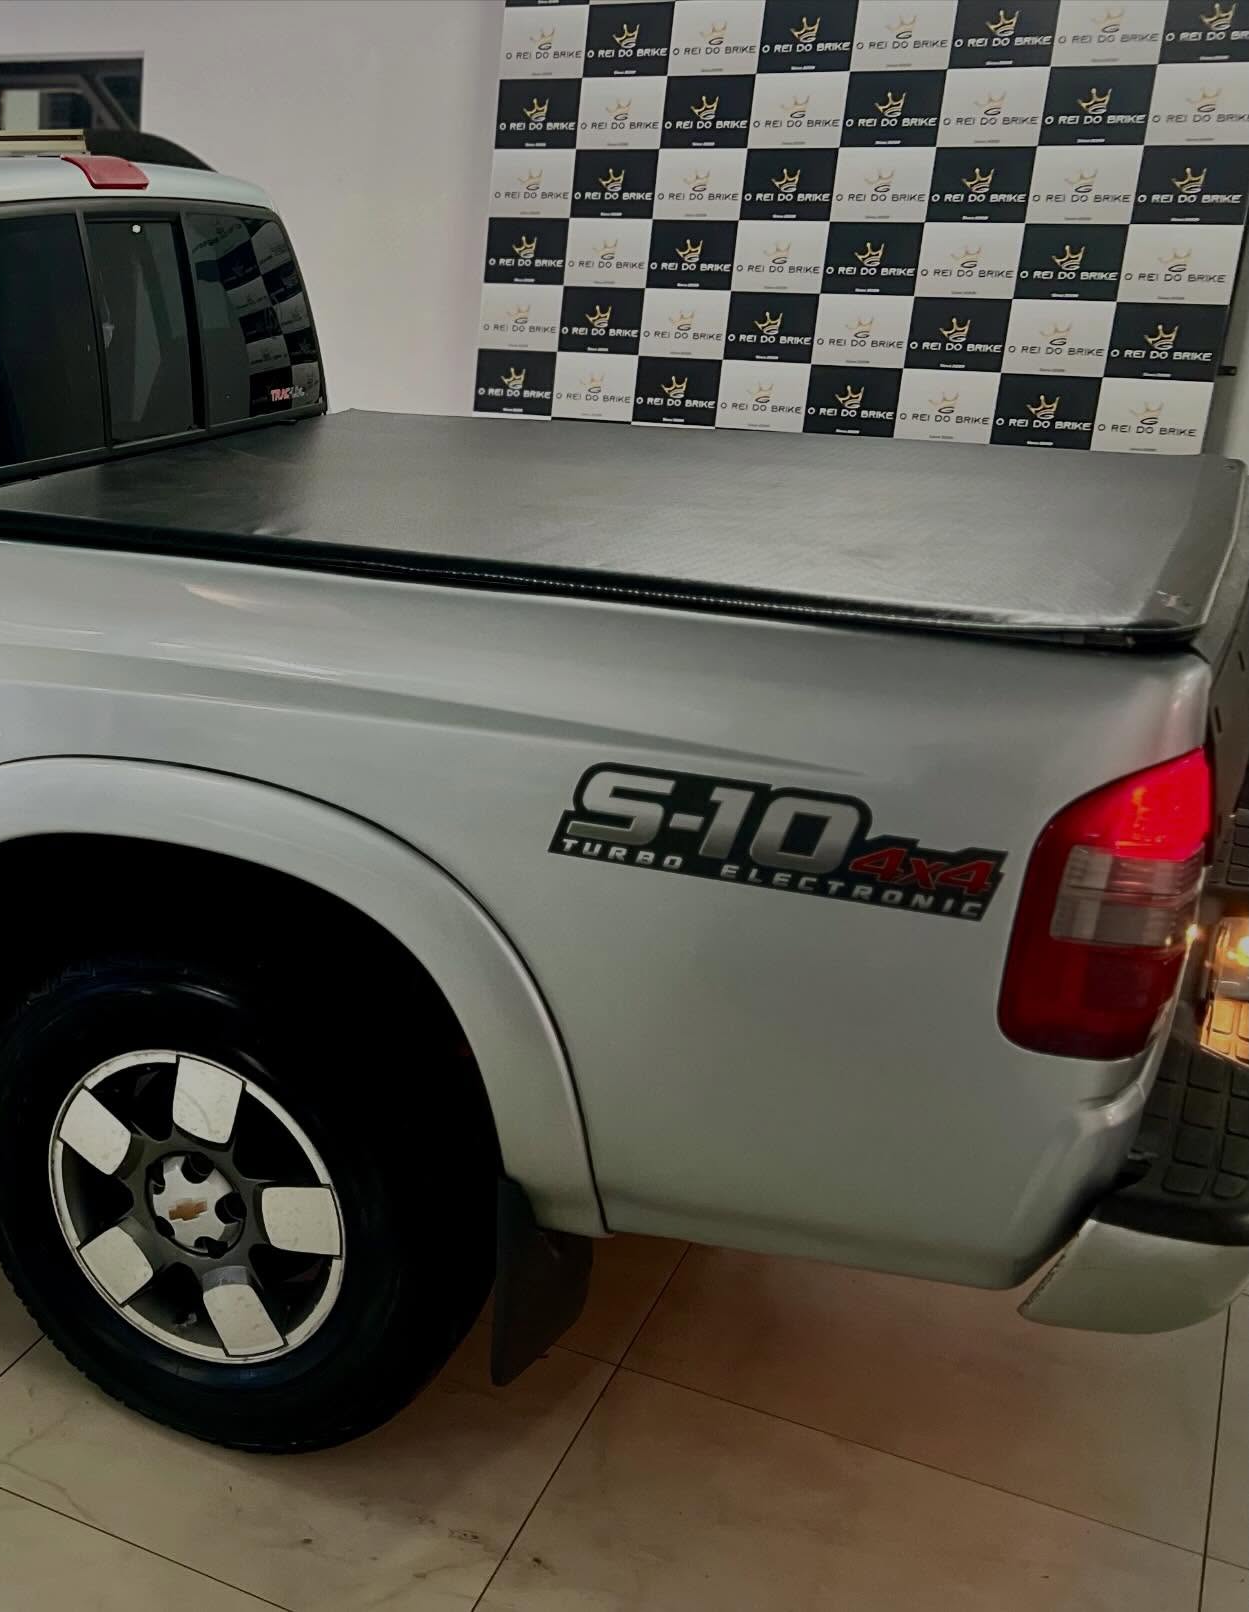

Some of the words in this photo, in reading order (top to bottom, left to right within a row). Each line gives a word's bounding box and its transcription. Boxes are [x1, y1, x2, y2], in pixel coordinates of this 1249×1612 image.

[1179, 31, 1203, 41] REI
[1206, 31, 1226, 41] DO
[912, 39, 948, 49] BRIKE
[967, 38, 989, 47] REI
[991, 37, 1011, 47] DO
[1013, 36, 1052, 46] BRIKE
[597, 49, 615, 58] REI
[618, 48, 634, 58] DO
[636, 47, 668, 57] BRIKE
[724, 45, 757, 55] BRIKE
[773, 44, 793, 53] REI
[796, 43, 813, 53] DO
[816, 42, 851, 52] BRIKE
[857, 118, 878, 127] REI
[880, 118, 898, 127] DO
[901, 117, 938, 127] BRIKE
[1058, 116, 1080, 125] REI
[1083, 115, 1103, 125] DO
[1106, 114, 1146, 124] BRIKE
[509, 122, 526, 131] REI
[528, 122, 543, 131] DO
[546, 121, 577, 131] BRIKE
[629, 121, 660, 130] BRIKE
[675, 121, 694, 130] REI
[696, 120, 713, 130] DO
[715, 120, 749, 129] BRIKE
[584, 191, 602, 200] REI
[604, 192, 619, 201] DO
[622, 192, 653, 201] BRIKE
[707, 193, 739, 201] BRIKE
[755, 193, 774, 202] REI
[777, 193, 794, 202] DO
[796, 193, 831, 202] BRIKE
[891, 193, 926, 202] BRIKE
[943, 194, 965, 203] REI
[967, 194, 986, 203] DO
[989, 194, 1027, 203] BRIKE
[1151, 194, 1174, 203] REI
[1177, 194, 1198, 204] DO
[1201, 194, 1242, 204] BRIKE
[498, 258, 515, 267] REI
[517, 258, 532, 267] DO
[534, 259, 565, 268] BRIKE
[660, 262, 679, 271] REI
[681, 262, 697, 271] DO
[699, 263, 732, 272] BRIKE
[788, 265, 820, 275] BRIKE
[837, 267, 857, 275] REI
[860, 267, 877, 276] DO
[880, 267, 916, 277] BRIKE
[977, 269, 1014, 279] BRIKE
[1032, 271, 1054, 280] REI
[1057, 271, 1076, 280] DO
[1079, 271, 1119, 281] BRIKE
[571, 326, 589, 336] REI
[591, 327, 606, 336] DO
[608, 328, 640, 338] BRIKE
[692, 332, 723, 341] BRIKE
[739, 334, 757, 343] REI
[760, 335, 776, 344] DO
[779, 335, 812, 345] BRIKE
[870, 340, 904, 349] BRIKE
[921, 341, 942, 351] REI
[945, 342, 963, 351] DO
[966, 343, 1003, 353] BRIKE
[1067, 347, 1105, 357] BRIKE
[1123, 349, 1147, 359] REI
[1149, 350, 1169, 360] DO
[1172, 351, 1213, 362] BRIKE
[487, 387, 504, 397] REI
[506, 388, 521, 397] DO
[523, 390, 552, 400] BRIKE
[646, 397, 664, 406] REI
[666, 398, 682, 407] DO
[684, 399, 717, 409] BRIKE
[818, 407, 838, 417] REI
[840, 408, 857, 418] DO
[860, 410, 895, 420] BRIKE
[1008, 418, 1029, 428] REI
[1032, 419, 1051, 429] DO
[1054, 421, 1093, 431] BRIKE
[1158, 427, 1197, 437] BRIKE
[565, 769, 860, 874] S-10
[849, 847, 997, 896] 4x4
[561, 838, 683, 872] TURBO
[720, 863, 984, 919] ELECTRONIC
